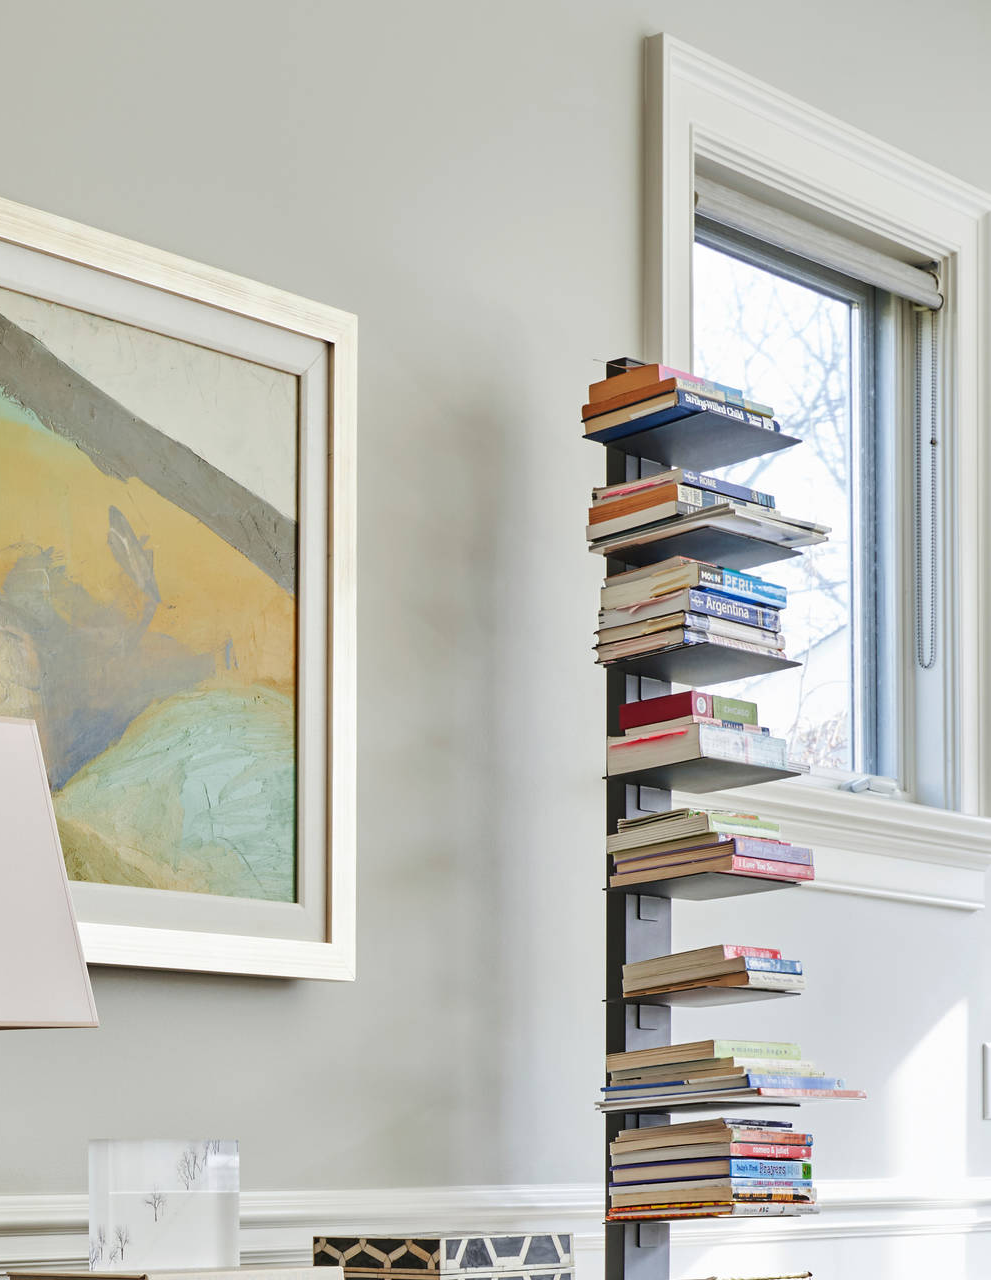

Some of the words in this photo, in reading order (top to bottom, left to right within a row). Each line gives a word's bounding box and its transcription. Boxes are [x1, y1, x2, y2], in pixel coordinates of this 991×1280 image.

[727, 408, 744, 420] Child
[699, 476, 716, 488] ROME
[724, 575, 754, 592] PERU
[706, 597, 749, 619] Argentina
[759, 1162, 785, 1175] Prayers
